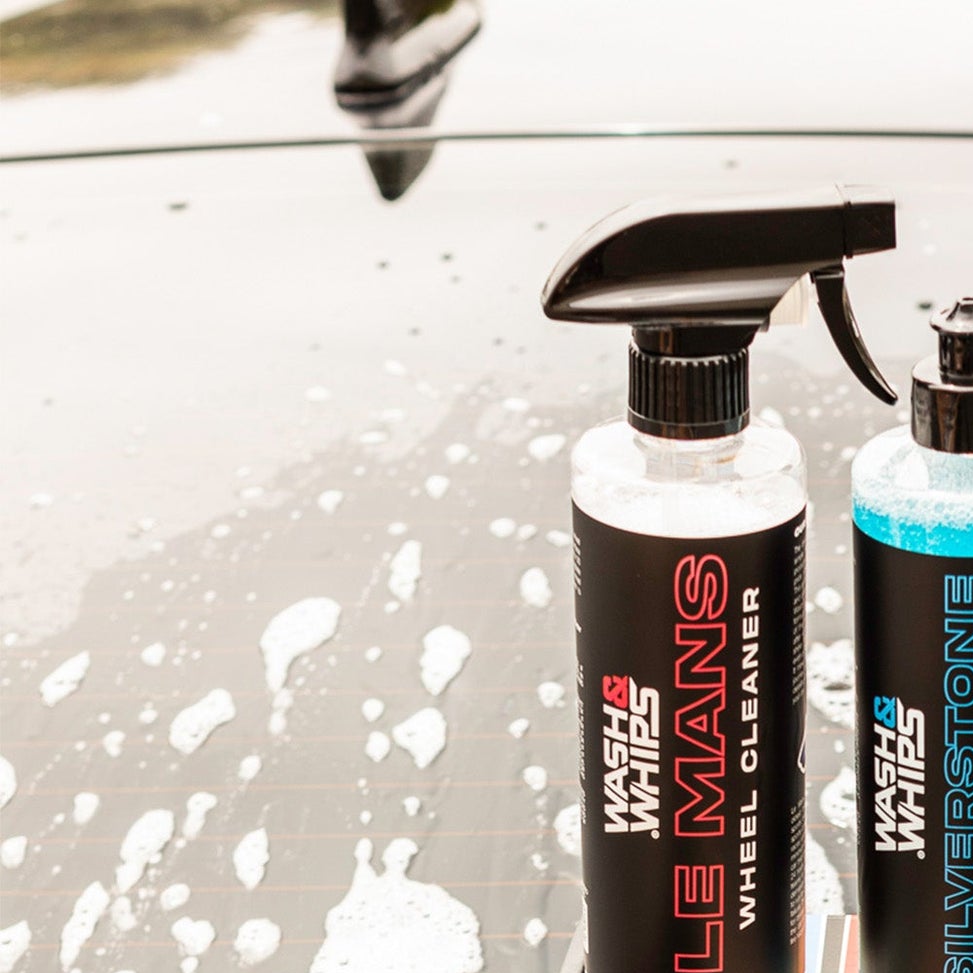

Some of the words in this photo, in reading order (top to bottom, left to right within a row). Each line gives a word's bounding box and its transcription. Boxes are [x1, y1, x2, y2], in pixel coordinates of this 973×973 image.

[629, 676, 660, 831] WHIPS
[673, 553, 729, 838] MANS
[740, 586, 760, 773] CLEANER
[895, 697, 925, 851] WHIPS
[739, 789, 758, 931] WHEEL
